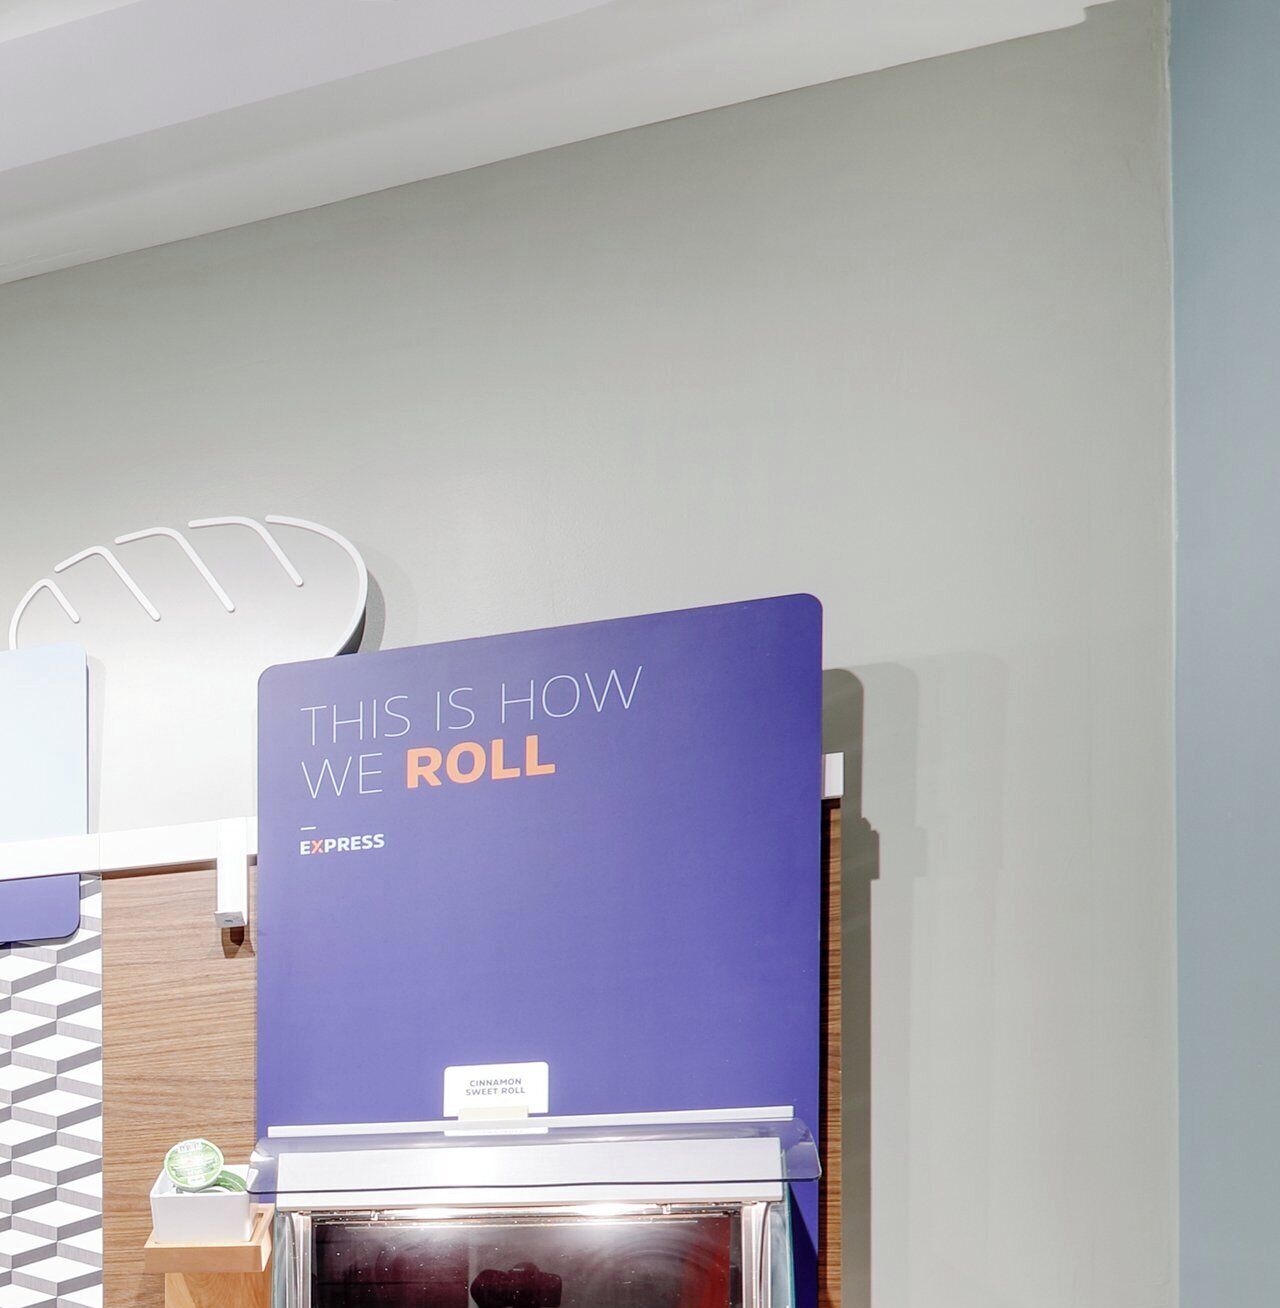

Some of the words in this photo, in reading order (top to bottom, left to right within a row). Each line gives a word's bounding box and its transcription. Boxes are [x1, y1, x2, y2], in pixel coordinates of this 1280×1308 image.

[300, 694, 411, 746] THIS
[436, 687, 475, 731] IS
[501, 665, 643, 724] HOW
[300, 752, 384, 800] WE
[406, 734, 556, 789] ROLL
[300, 833, 385, 856] EXPRESS
[465, 1088, 498, 1096] SWEET
[501, 1087, 526, 1095] ROLL
[469, 1078, 522, 1087] CINNAMON
